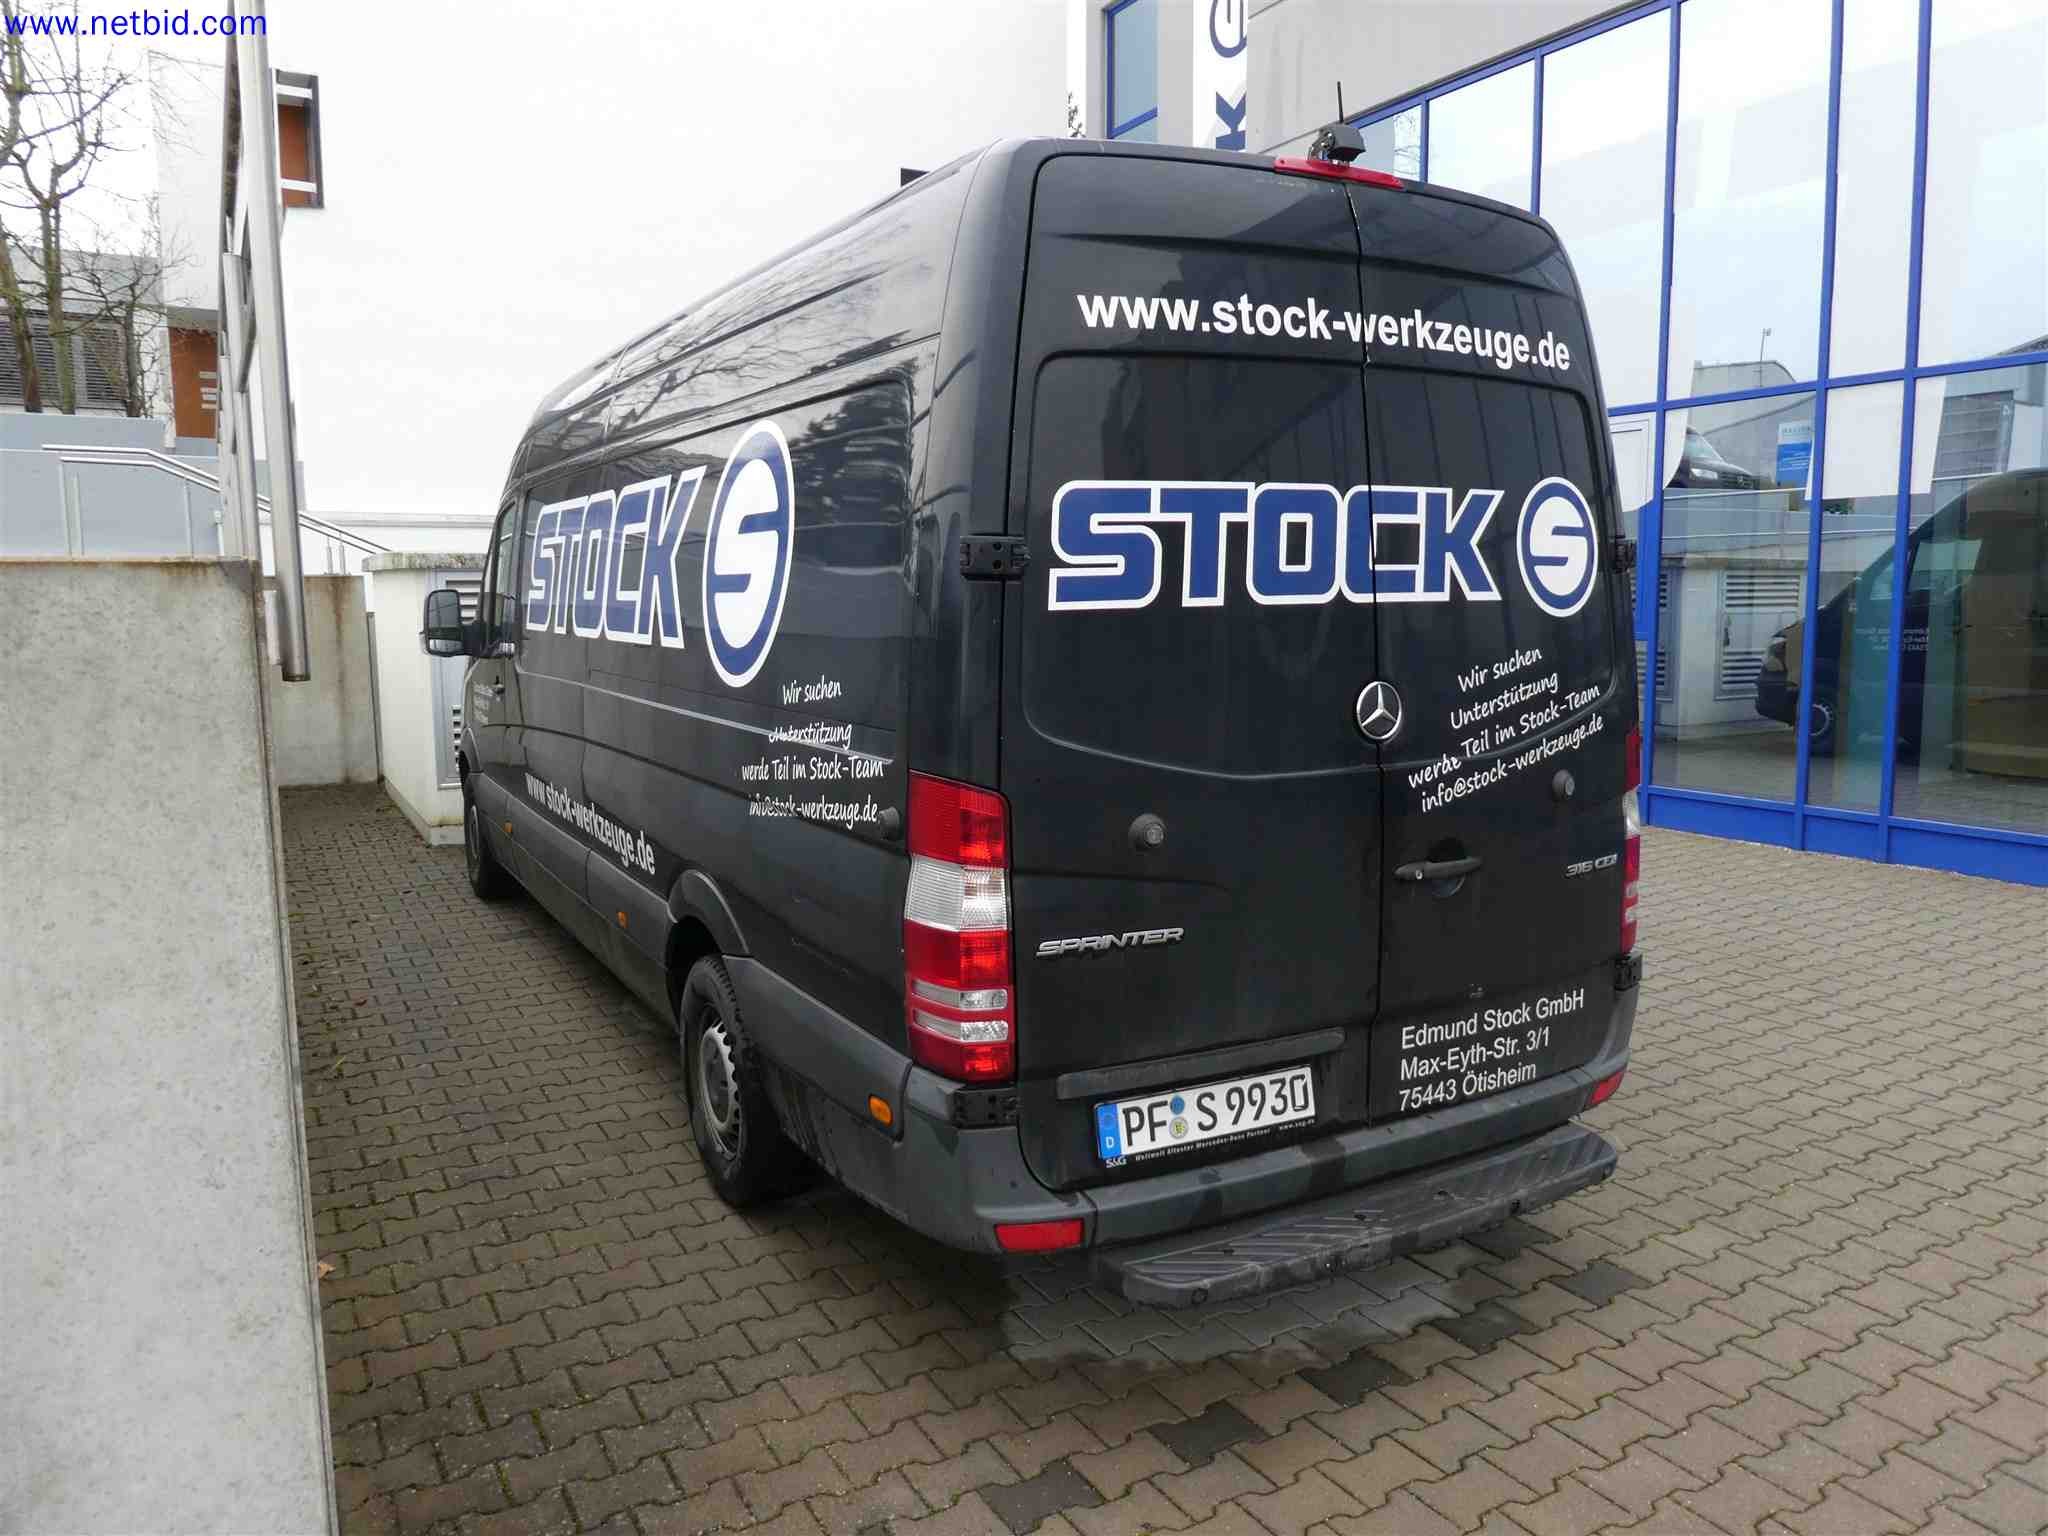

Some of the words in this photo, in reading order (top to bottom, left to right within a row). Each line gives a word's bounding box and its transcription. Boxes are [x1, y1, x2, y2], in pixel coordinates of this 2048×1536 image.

[1077, 293, 1571, 370] www.stock-werkzeuge.de
[526, 466, 707, 649] STOCK
[1047, 479, 1505, 611] STOCK
[783, 680, 801, 705] Wir
[804, 675, 842, 702] suchen
[1457, 665, 1489, 693] Wir
[1493, 647, 1542, 680] suchen
[1450, 672, 1560, 730] Unterstützung
[1408, 754, 1462, 789] werde
[1461, 731, 1490, 759] Teil
[1495, 724, 1516, 745] im
[1519, 684, 1601, 734] Stock-Team
[1421, 713, 1604, 813] info@stock-werkzeuge.de
[741, 757, 769, 781] werde
[772, 756, 789, 780] Teil
[792, 755, 807, 780] im
[809, 753, 884, 780] Stock-Team
[1036, 927, 1185, 957] SPRINTER
[1401, 1013, 1478, 1049] Edmund
[1483, 1001, 1531, 1032] Stock
[1535, 988, 1585, 1019] GmbH
[1401, 1037, 1520, 1081] Max-Eyth-Str.
[1525, 1026, 1550, 1051] 3/1
[1105, 1136, 1115, 1149] D
[1122, 1100, 1169, 1146] PF
[1226, 1074, 1310, 1126] 9930
[1399, 1079, 1457, 1112] 75443
[1462, 1062, 1537, 1096] Ötisheim
